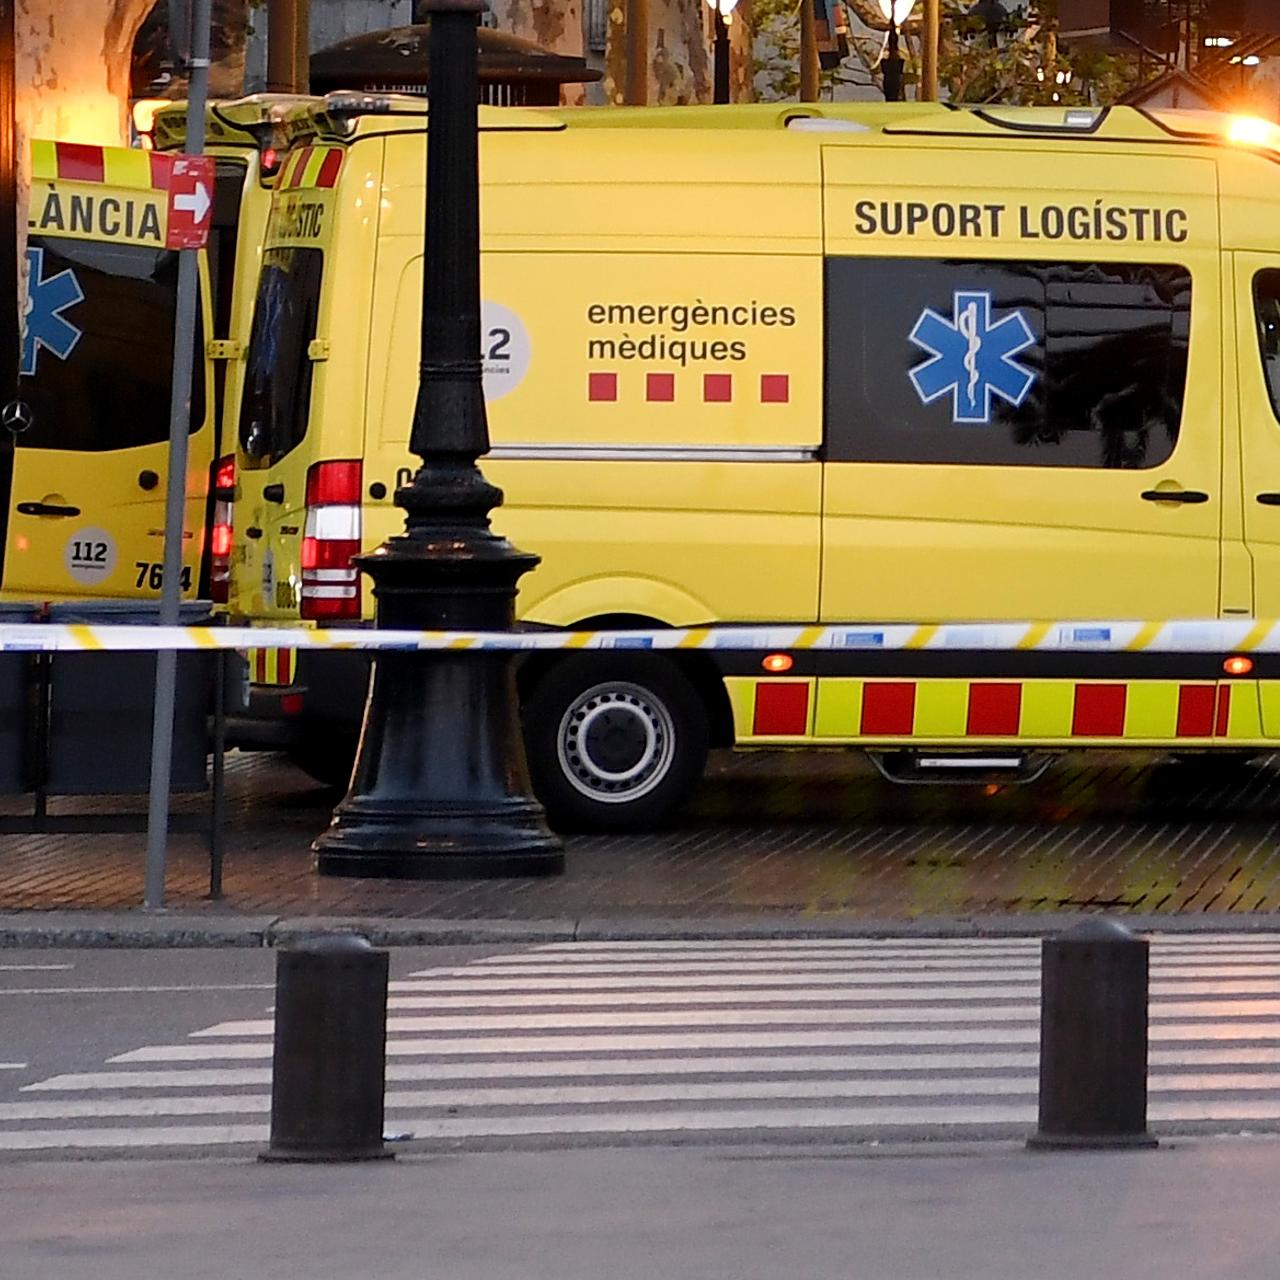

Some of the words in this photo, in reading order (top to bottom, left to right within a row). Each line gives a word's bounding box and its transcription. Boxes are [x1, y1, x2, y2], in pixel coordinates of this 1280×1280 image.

[28, 183, 161, 241] ÀNCIA
[855, 200, 1005, 237] SUPORT
[1020, 198, 1188, 242] LOGÍSTIC
[588, 299, 796, 332] emergències
[588, 333, 746, 367] mèdiques
[72, 541, 108, 562] 112
[136, 562, 192, 592] 764
